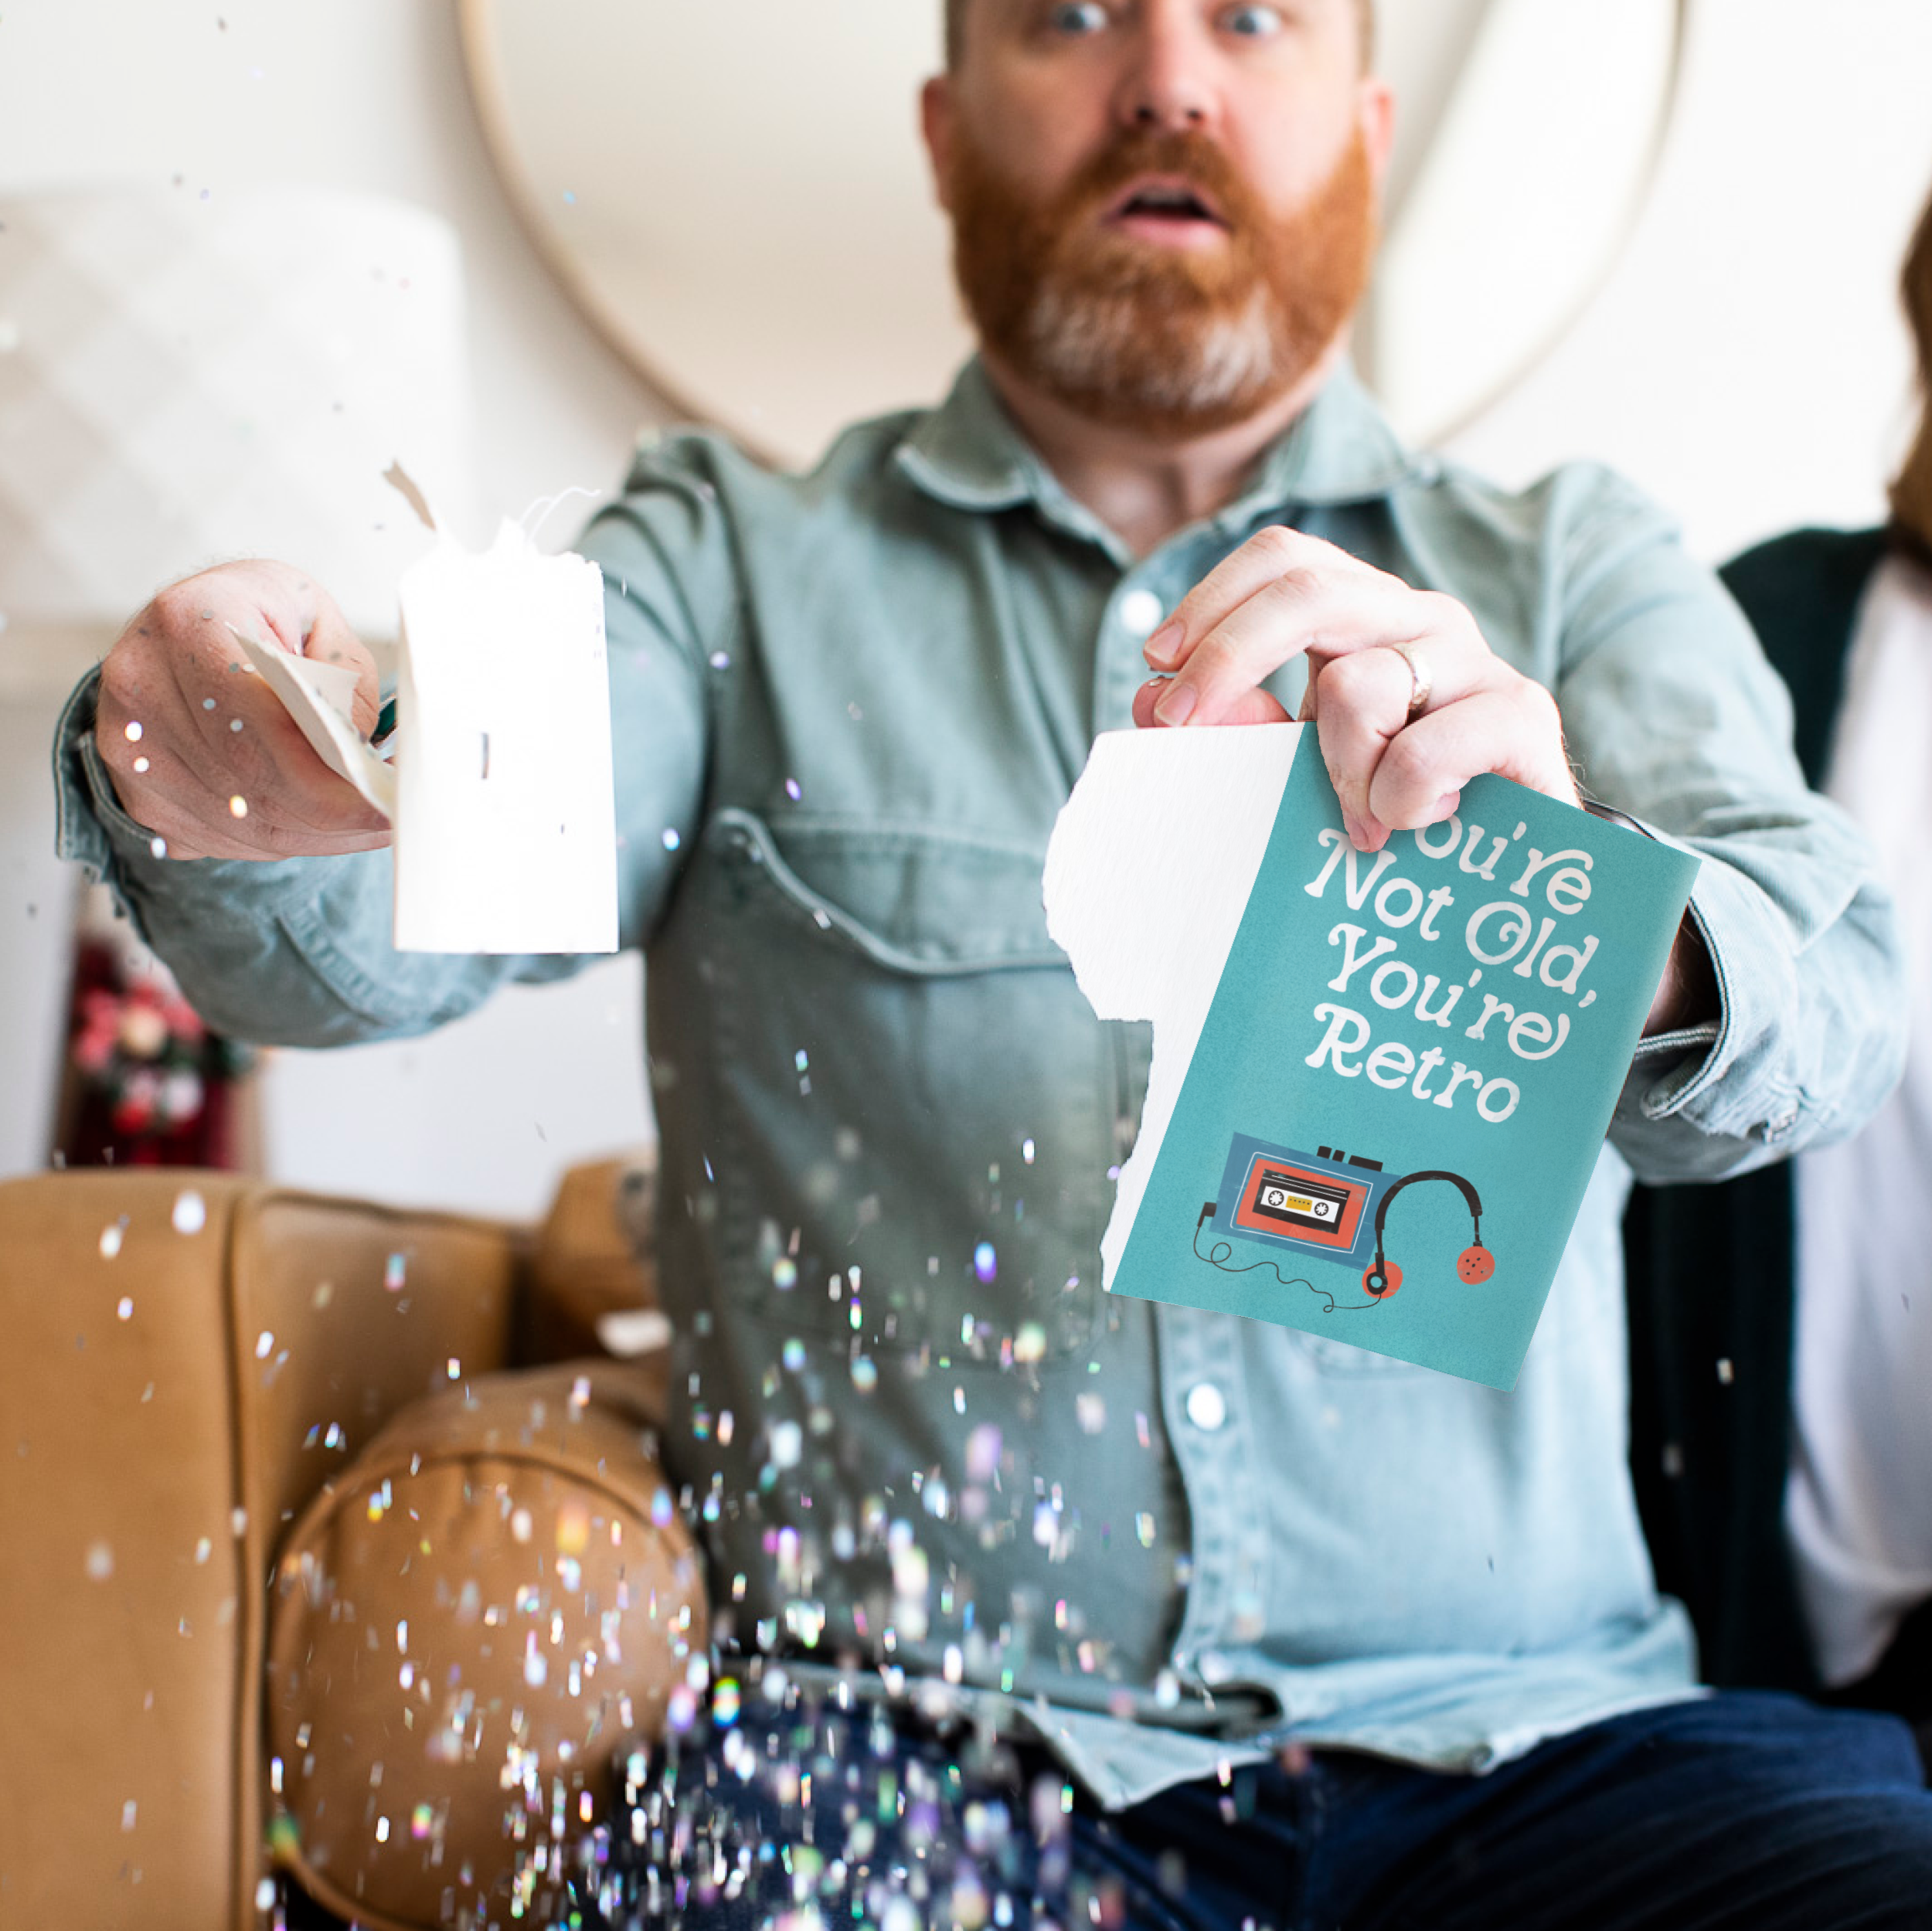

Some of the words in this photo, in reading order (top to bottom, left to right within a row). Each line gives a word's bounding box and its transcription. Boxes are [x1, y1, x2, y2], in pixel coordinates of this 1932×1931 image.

[1304, 828, 1454, 941] Not
[1465, 901, 1600, 1008] Old,
[1414, 814, 1594, 915] ou're
[1328, 923, 1570, 1060] You're
[1304, 1002, 1520, 1123] Retro
